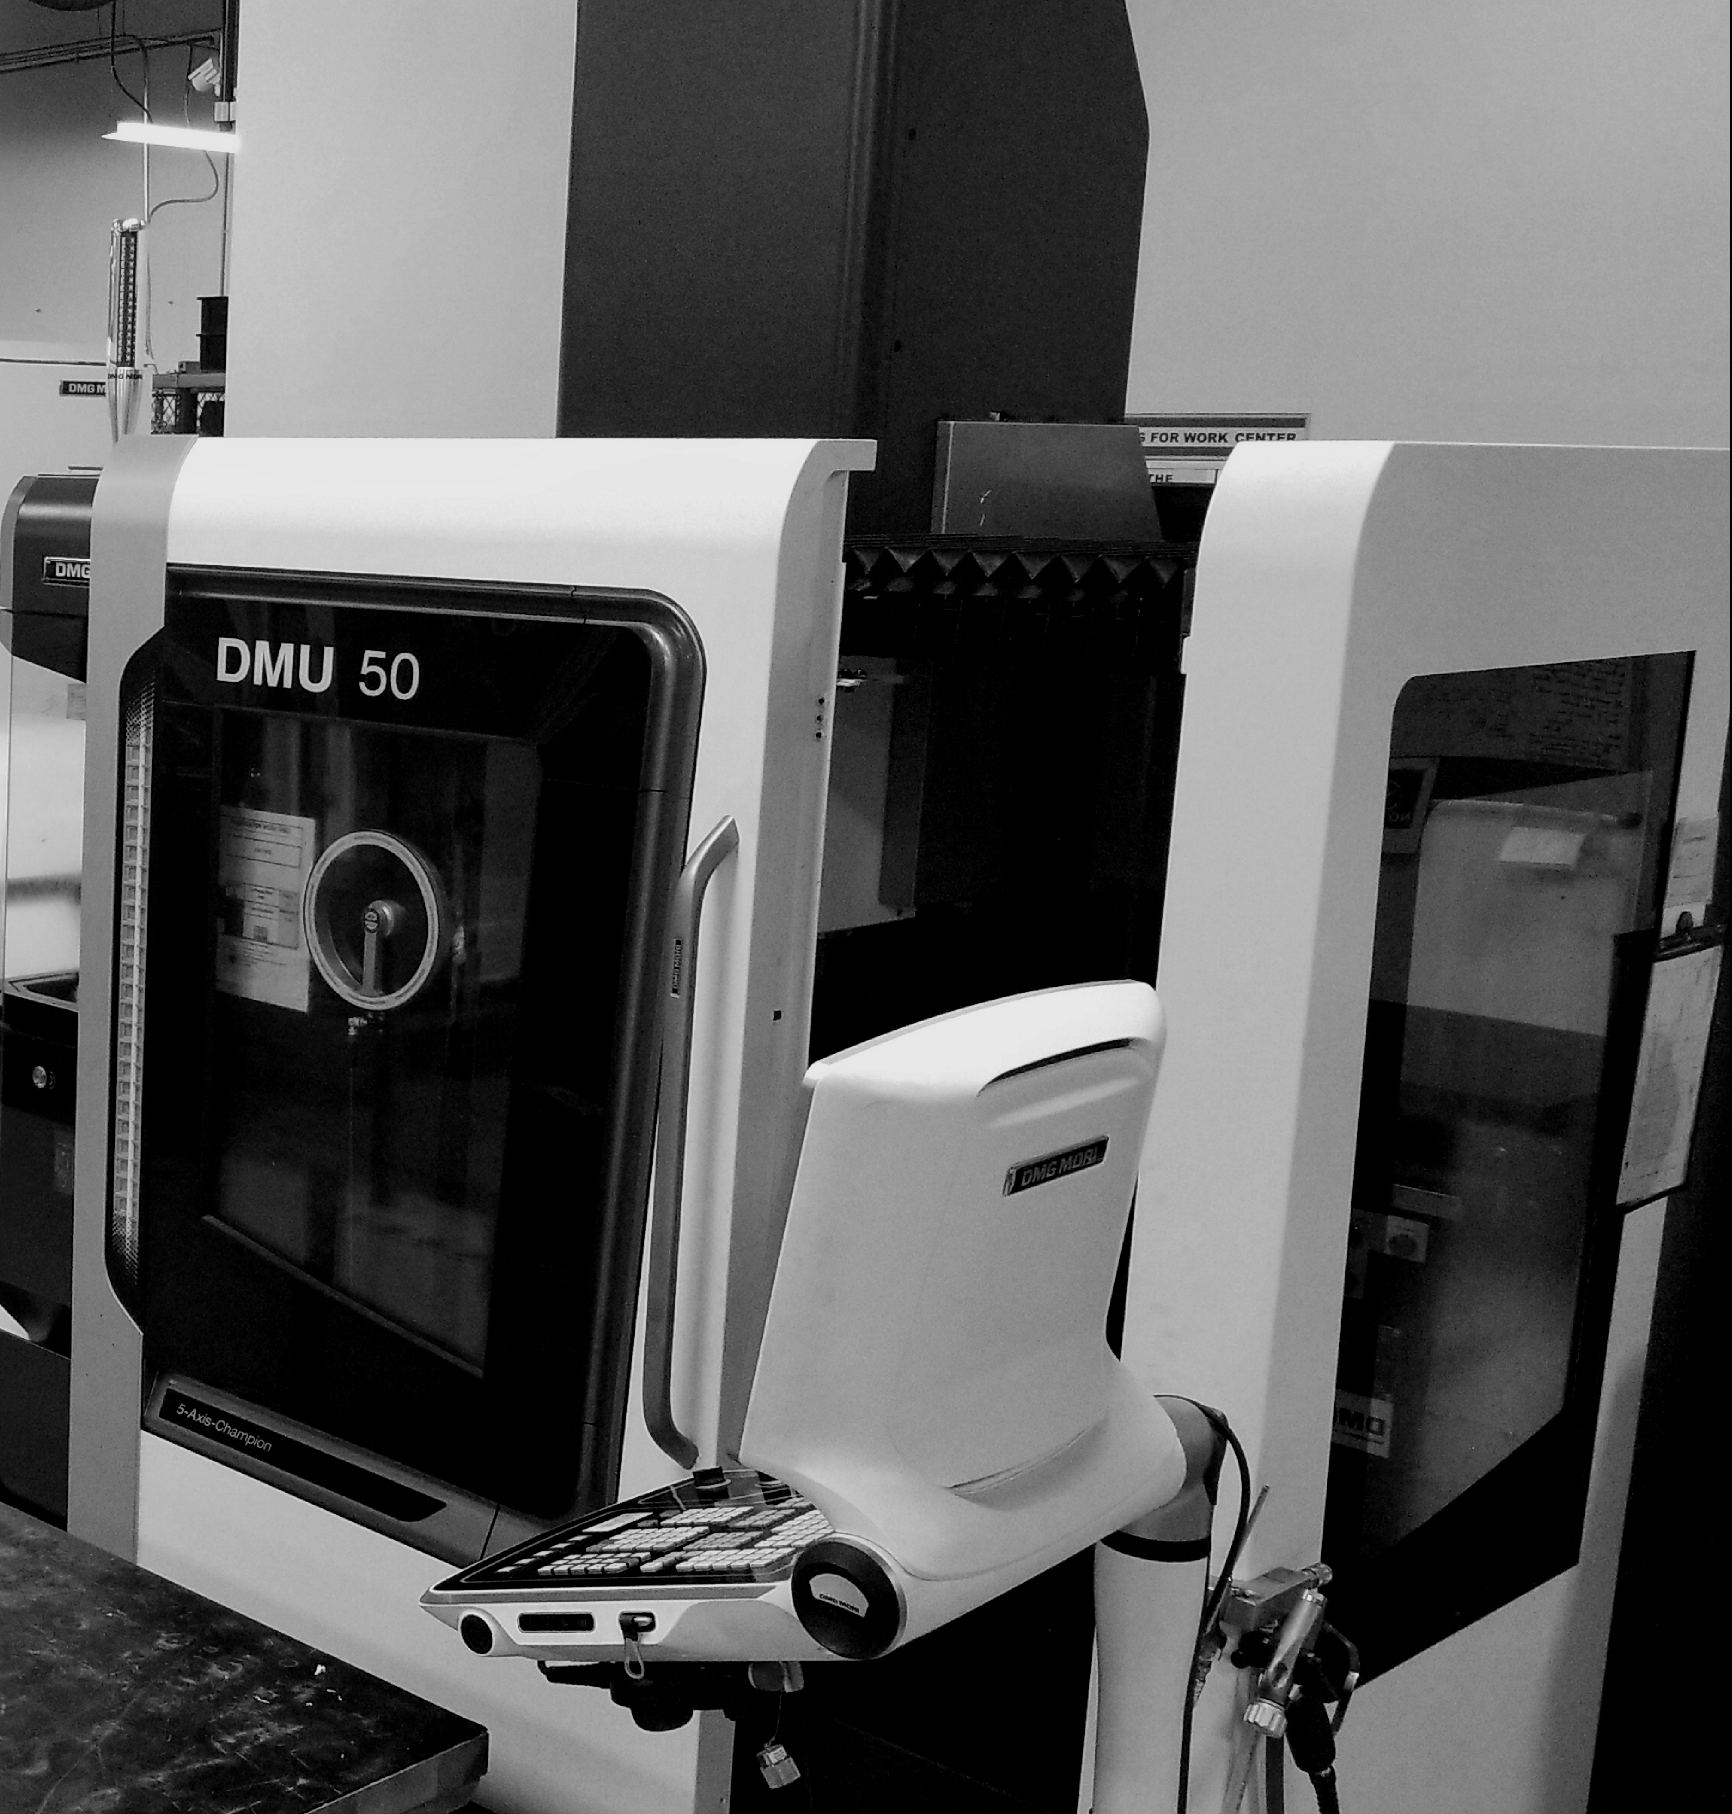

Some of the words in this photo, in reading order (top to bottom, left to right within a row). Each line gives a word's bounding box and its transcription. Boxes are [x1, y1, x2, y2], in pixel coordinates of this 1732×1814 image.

[68, 383, 95, 393] DMG
[1150, 432, 1179, 443] FOR
[1184, 432, 1228, 443] WORK
[55, 562, 91, 578] DMG
[216, 636, 335, 693] DMU
[359, 649, 420, 700] 50
[1021, 1161, 1058, 1187] DMG
[1058, 1146, 1099, 1175] MORI
[176, 1403, 273, 1452] 5-Axis-Champion
